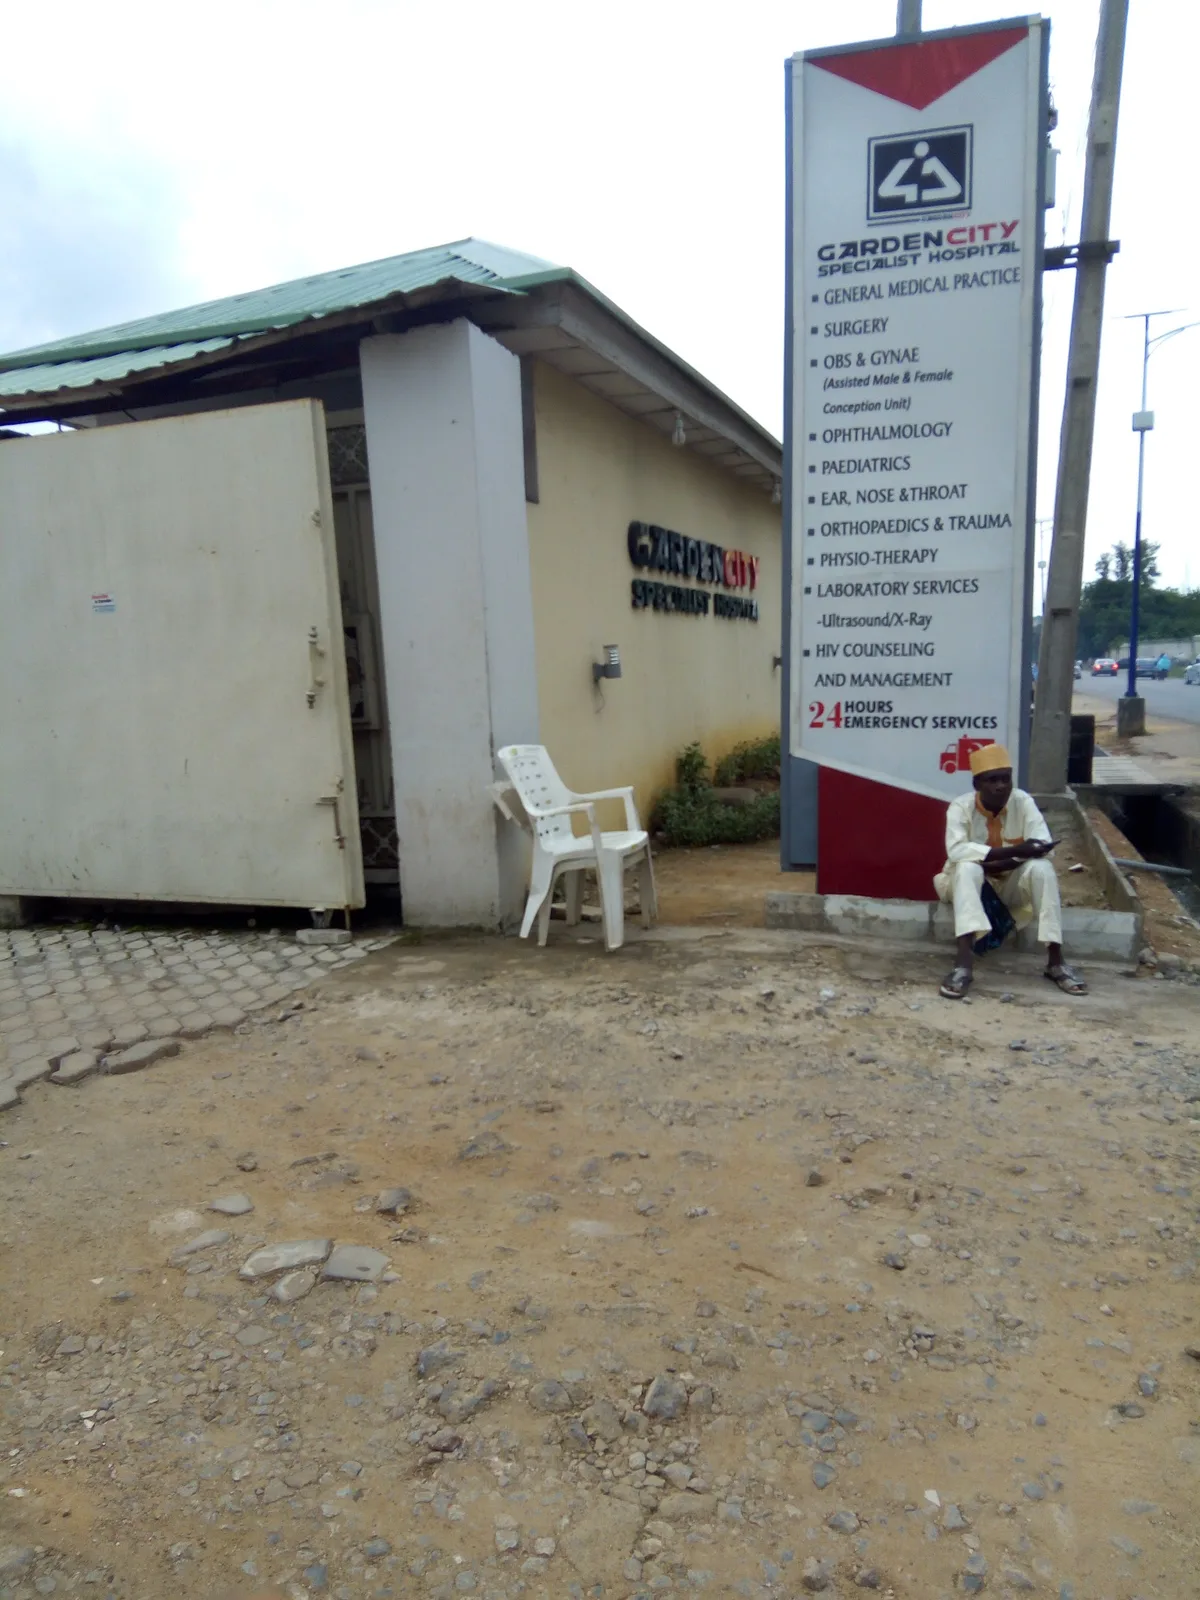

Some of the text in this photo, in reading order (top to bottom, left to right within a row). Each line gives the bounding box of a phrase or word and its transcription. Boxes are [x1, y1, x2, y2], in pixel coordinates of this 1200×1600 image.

[817, 241, 1020, 278] SPECIALIST HOSPITAL
[824, 267, 1020, 305] GENERAL MEDICAL PRACTICE
[823, 317, 889, 337] SURGERY
[823, 348, 919, 369] OBS & GYNAE
[823, 369, 953, 391] (Assisted Male & Female
[823, 397, 911, 415] Conception Unit)
[822, 422, 953, 443] OPHTHALMOLOGY
[822, 455, 911, 475] PAEDIATRICS
[821, 490, 851, 507] EAR,
[856, 488, 894, 504] NOSE
[820, 513, 1012, 537] ORTHOPAEDICS & TRAUMA
[820, 548, 939, 567] PHYSIO-THERAPY
[817, 578, 979, 598] LABORATORY SERVICES
[816, 642, 935, 657] HIV COUNSELING
[814, 672, 953, 687] AND MANAGEMENT
[808, 700, 893, 729] 24 HOURS
[843, 716, 998, 729] EMERGENCY SERVICES
